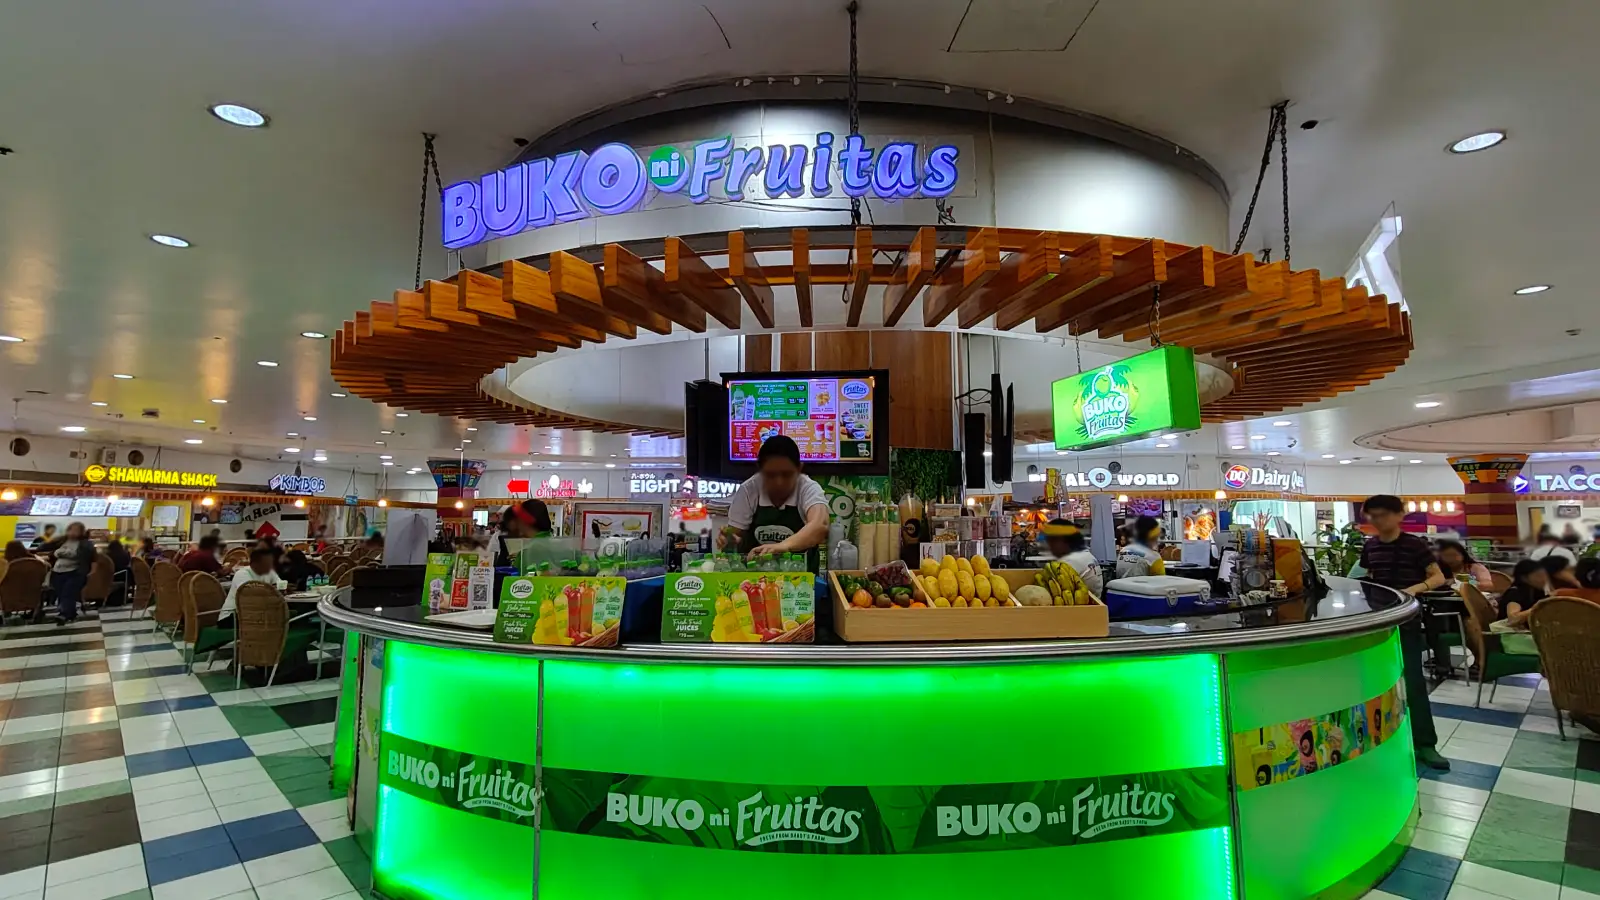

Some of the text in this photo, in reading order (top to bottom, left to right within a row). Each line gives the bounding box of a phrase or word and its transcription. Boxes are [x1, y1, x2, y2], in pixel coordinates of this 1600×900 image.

[441, 132, 959, 249] BUKO ni Fruitas
[844, 385, 868, 396] Fruitas
[1084, 394, 1128, 421] BUKO
[1088, 414, 1124, 436] Fruitas
[108, 466, 217, 487] SHAWARMA SHACK
[280, 475, 327, 493] KIMBOB
[630, 479, 681, 493] EIGHT
[1117, 473, 1180, 486] WORLD
[1229, 470, 1247, 482] DQ
[1251, 467, 1290, 491] Dairy
[512, 584, 533, 594] Fruitas
[677, 581, 702, 591] Fruitas
[387, 749, 545, 811] BUKO ni Fruitas
[606, 790, 863, 843] BUKO ni Fruitas
[936, 783, 1176, 837] BUKO ni Fruitas
